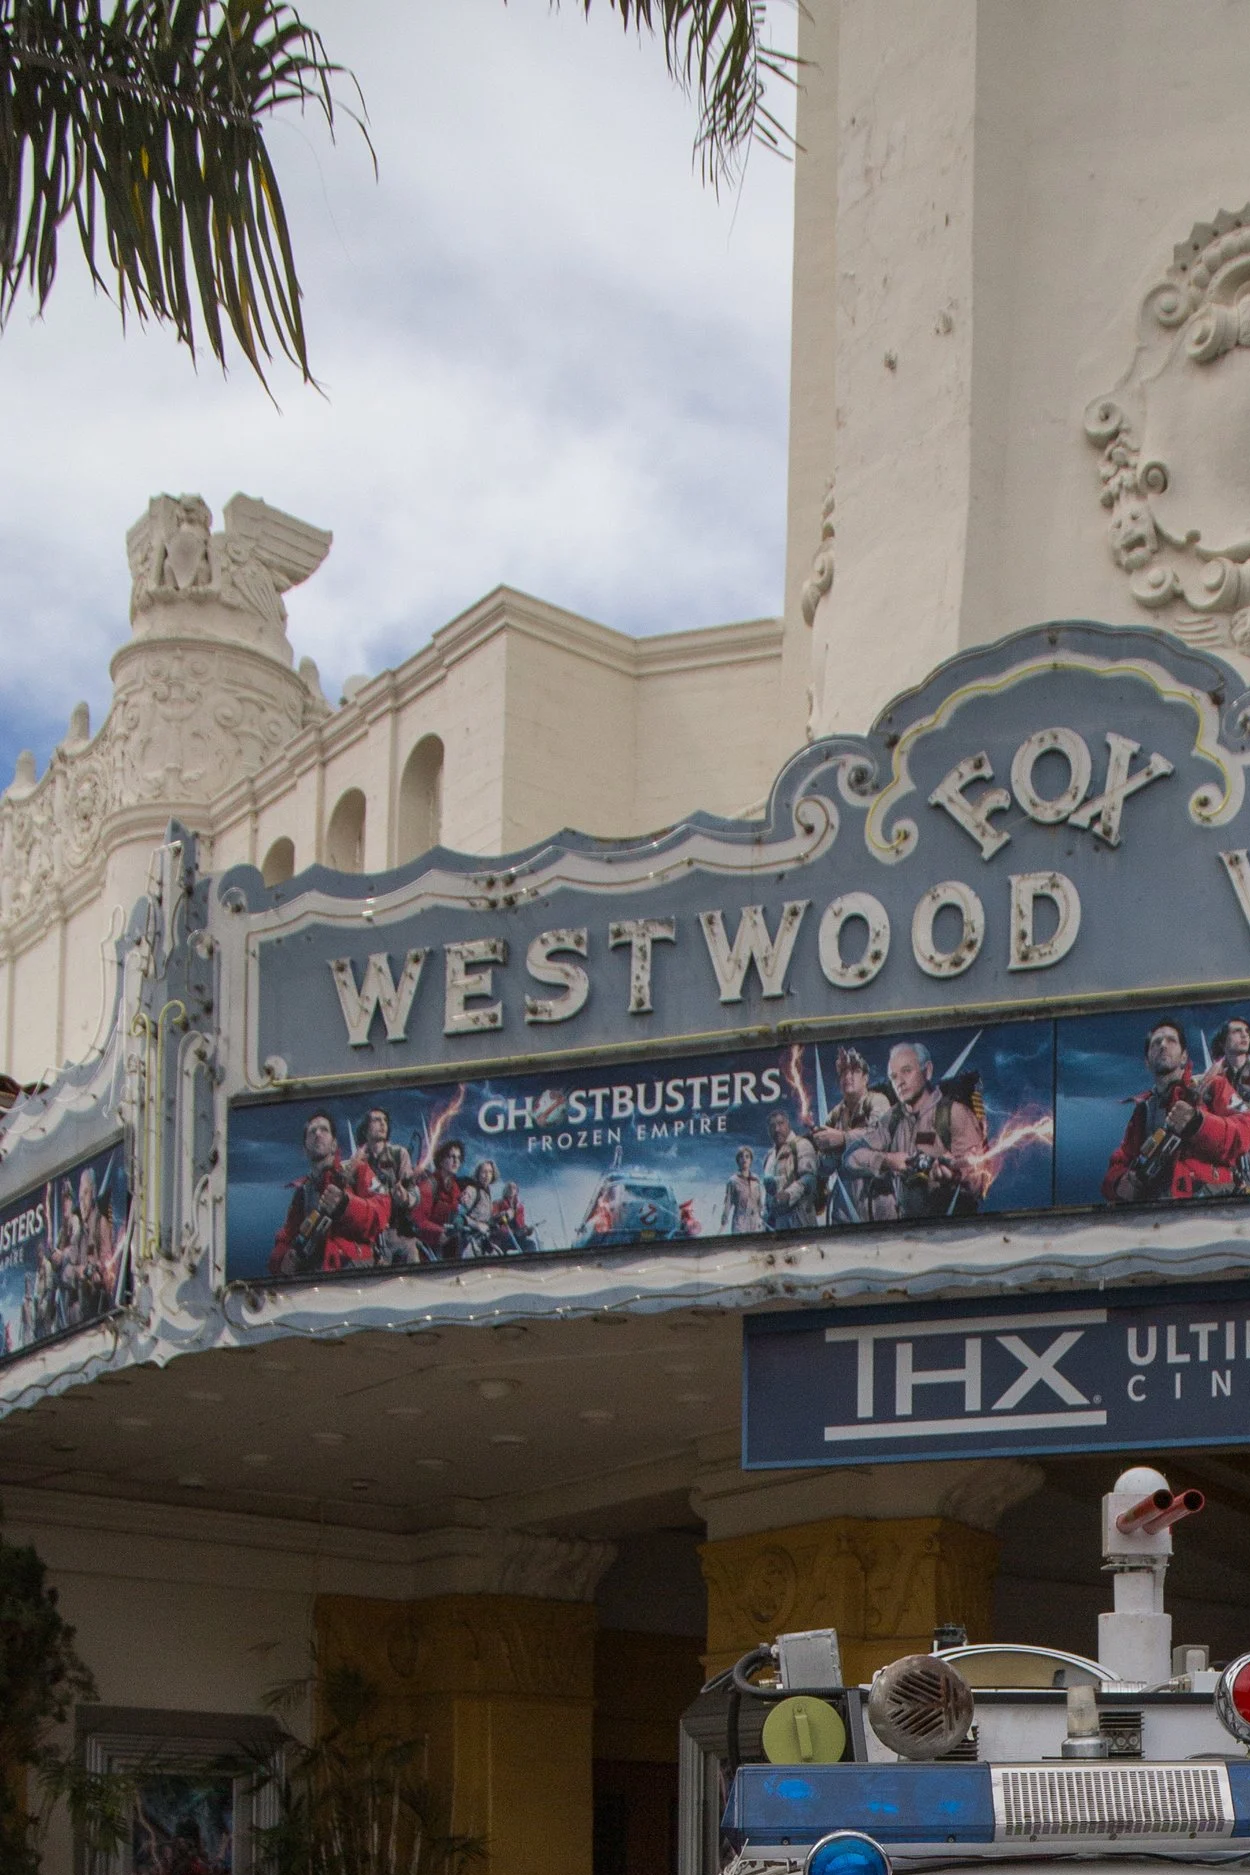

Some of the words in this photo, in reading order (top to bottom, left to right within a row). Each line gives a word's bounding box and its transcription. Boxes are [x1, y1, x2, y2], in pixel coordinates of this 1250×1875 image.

[928, 727, 1174, 861] FOX
[327, 872, 1082, 1047] WESTWOOD
[477, 1067, 782, 1134] GHOSTBUSTERS
[527, 1127, 622, 1152] FROZEN
[636, 1115, 728, 1141] EMPIRE
[824, 1309, 1107, 1420] THX
